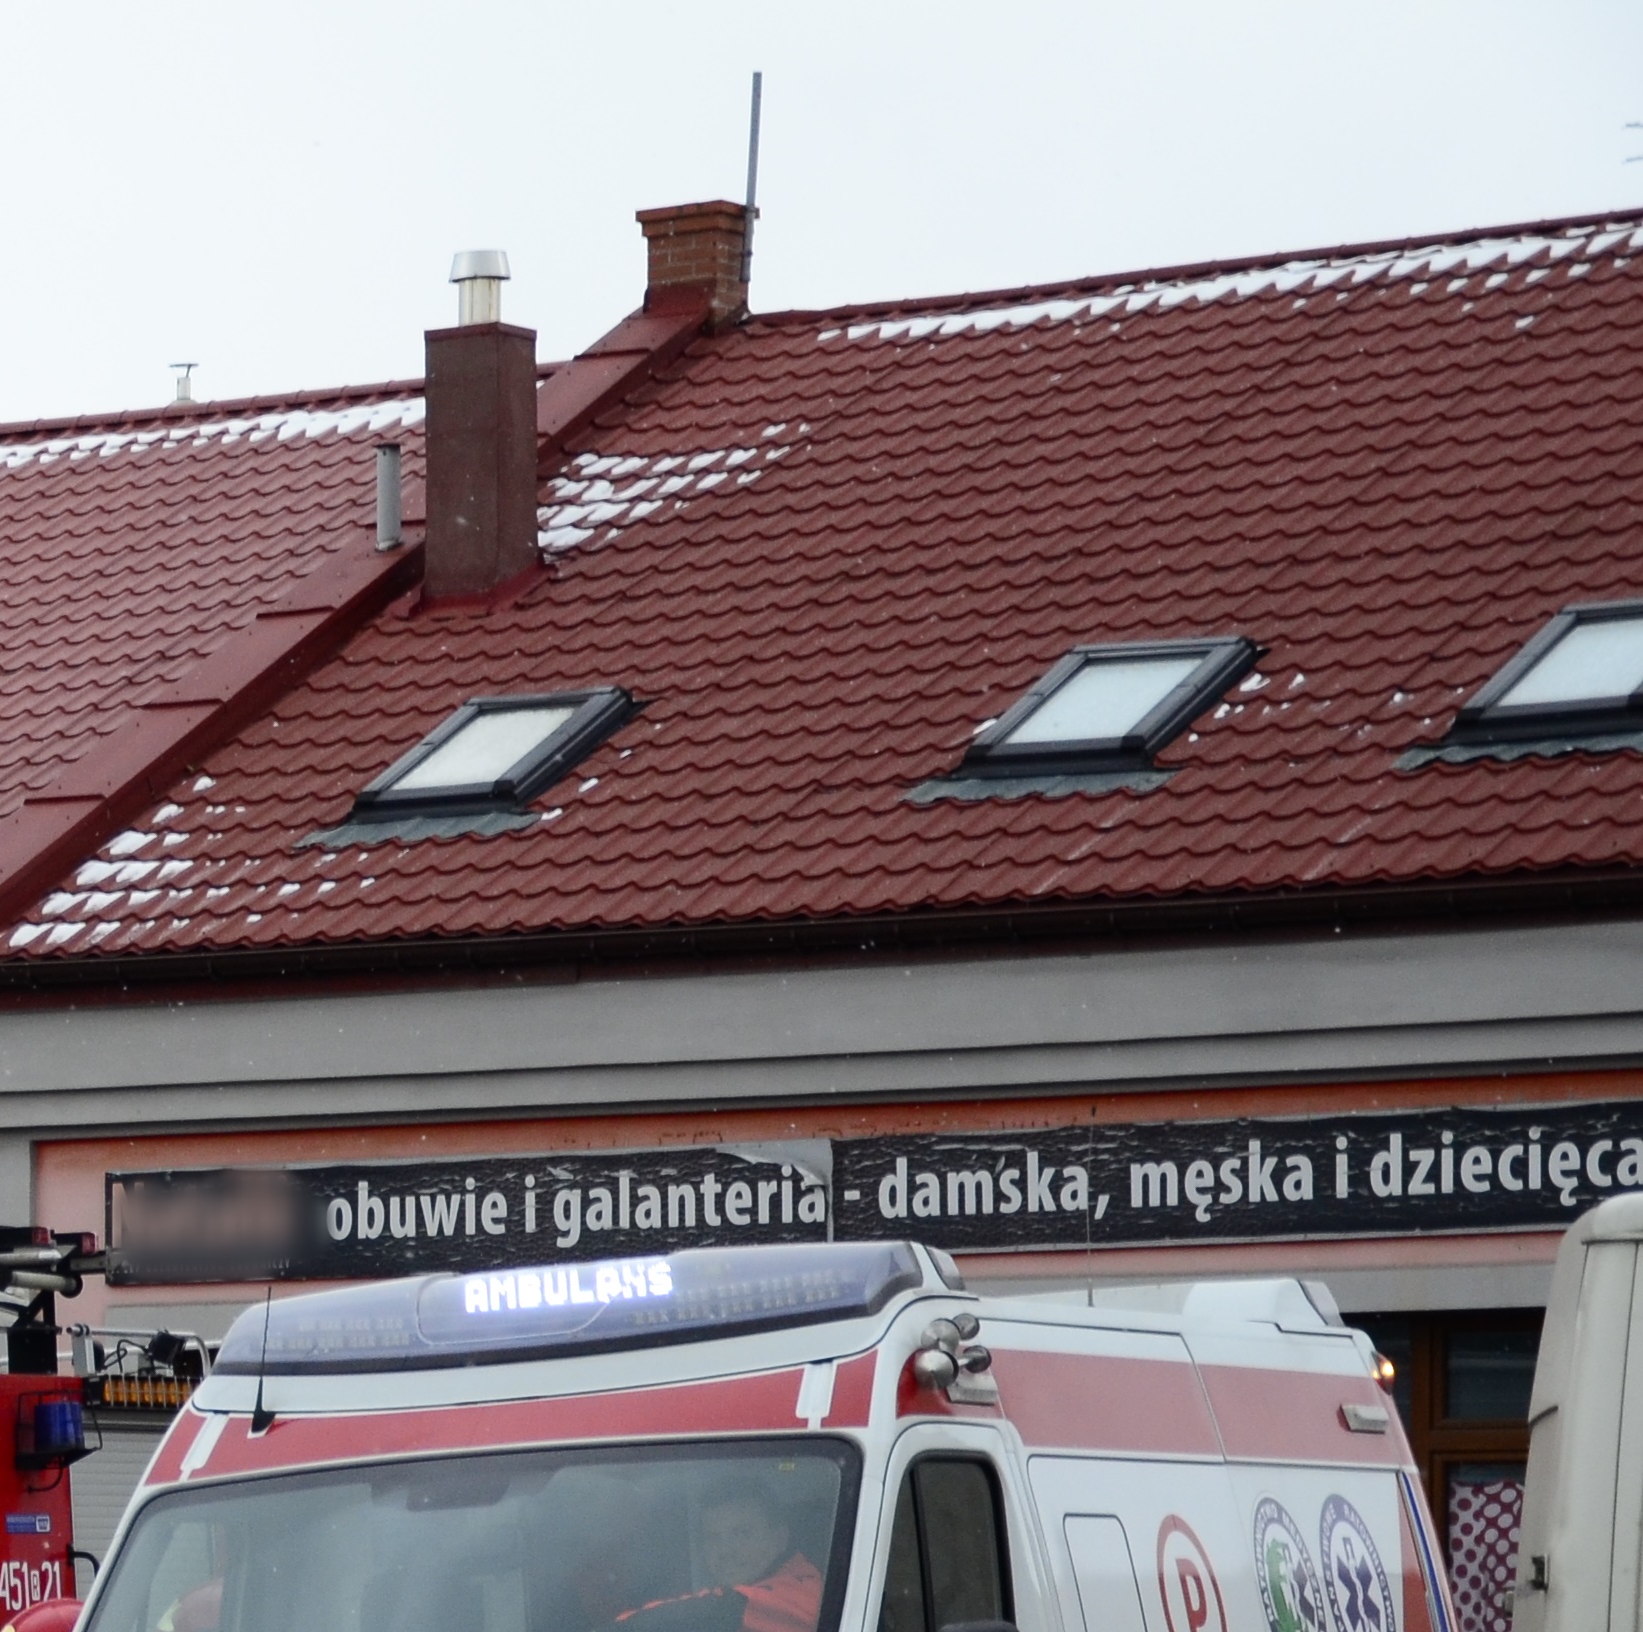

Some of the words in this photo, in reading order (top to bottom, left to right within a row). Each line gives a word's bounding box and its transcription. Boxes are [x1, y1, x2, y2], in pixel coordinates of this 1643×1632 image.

[327, 1176, 508, 1241] obuwie
[524, 1175, 536, 1233] i
[554, 1165, 826, 1248] galanteria
[1130, 1138, 1313, 1223] męska
[1334, 1137, 1349, 1199] i
[1371, 1126, 1643, 1207] dziecięca
[465, 1262, 673, 1313] AMBULANS
